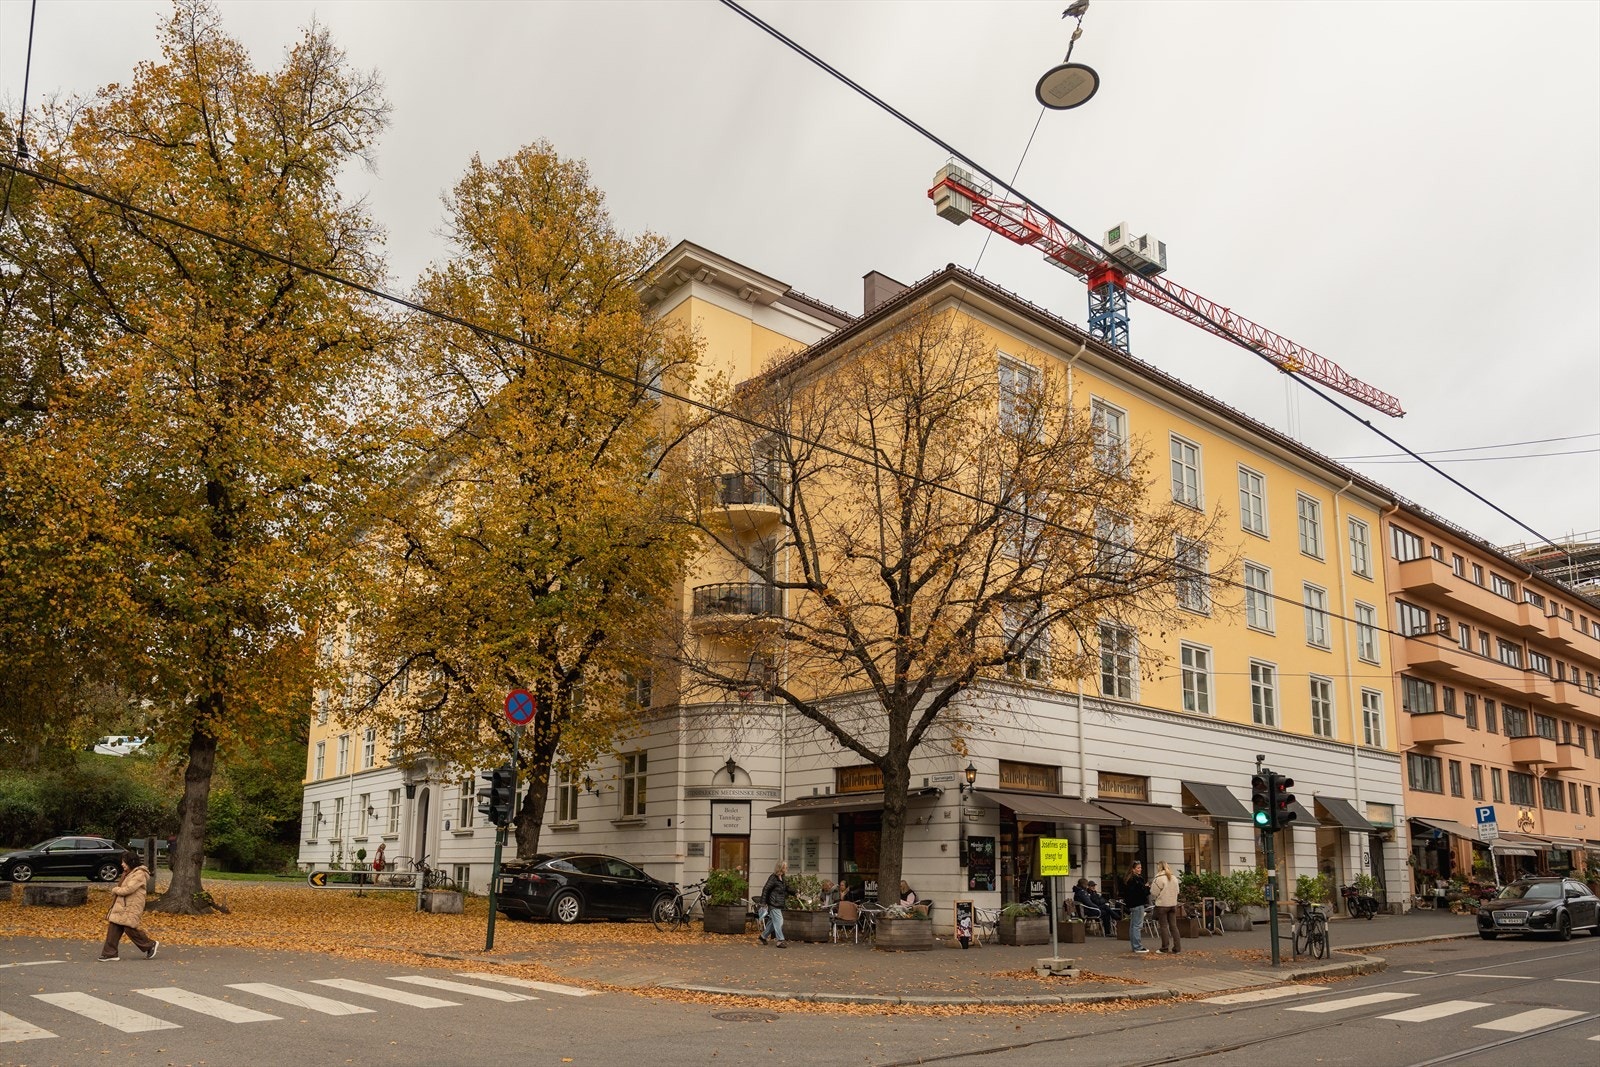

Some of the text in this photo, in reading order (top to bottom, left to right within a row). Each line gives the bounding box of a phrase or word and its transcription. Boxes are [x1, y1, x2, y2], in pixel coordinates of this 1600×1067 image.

[756, 789, 777, 797] SENTER
[1480, 808, 1490, 821] P
[1059, 842, 1067, 850] gate
[1045, 853, 1056, 861] stengt
[1031, 881, 1043, 891] Kaffe
